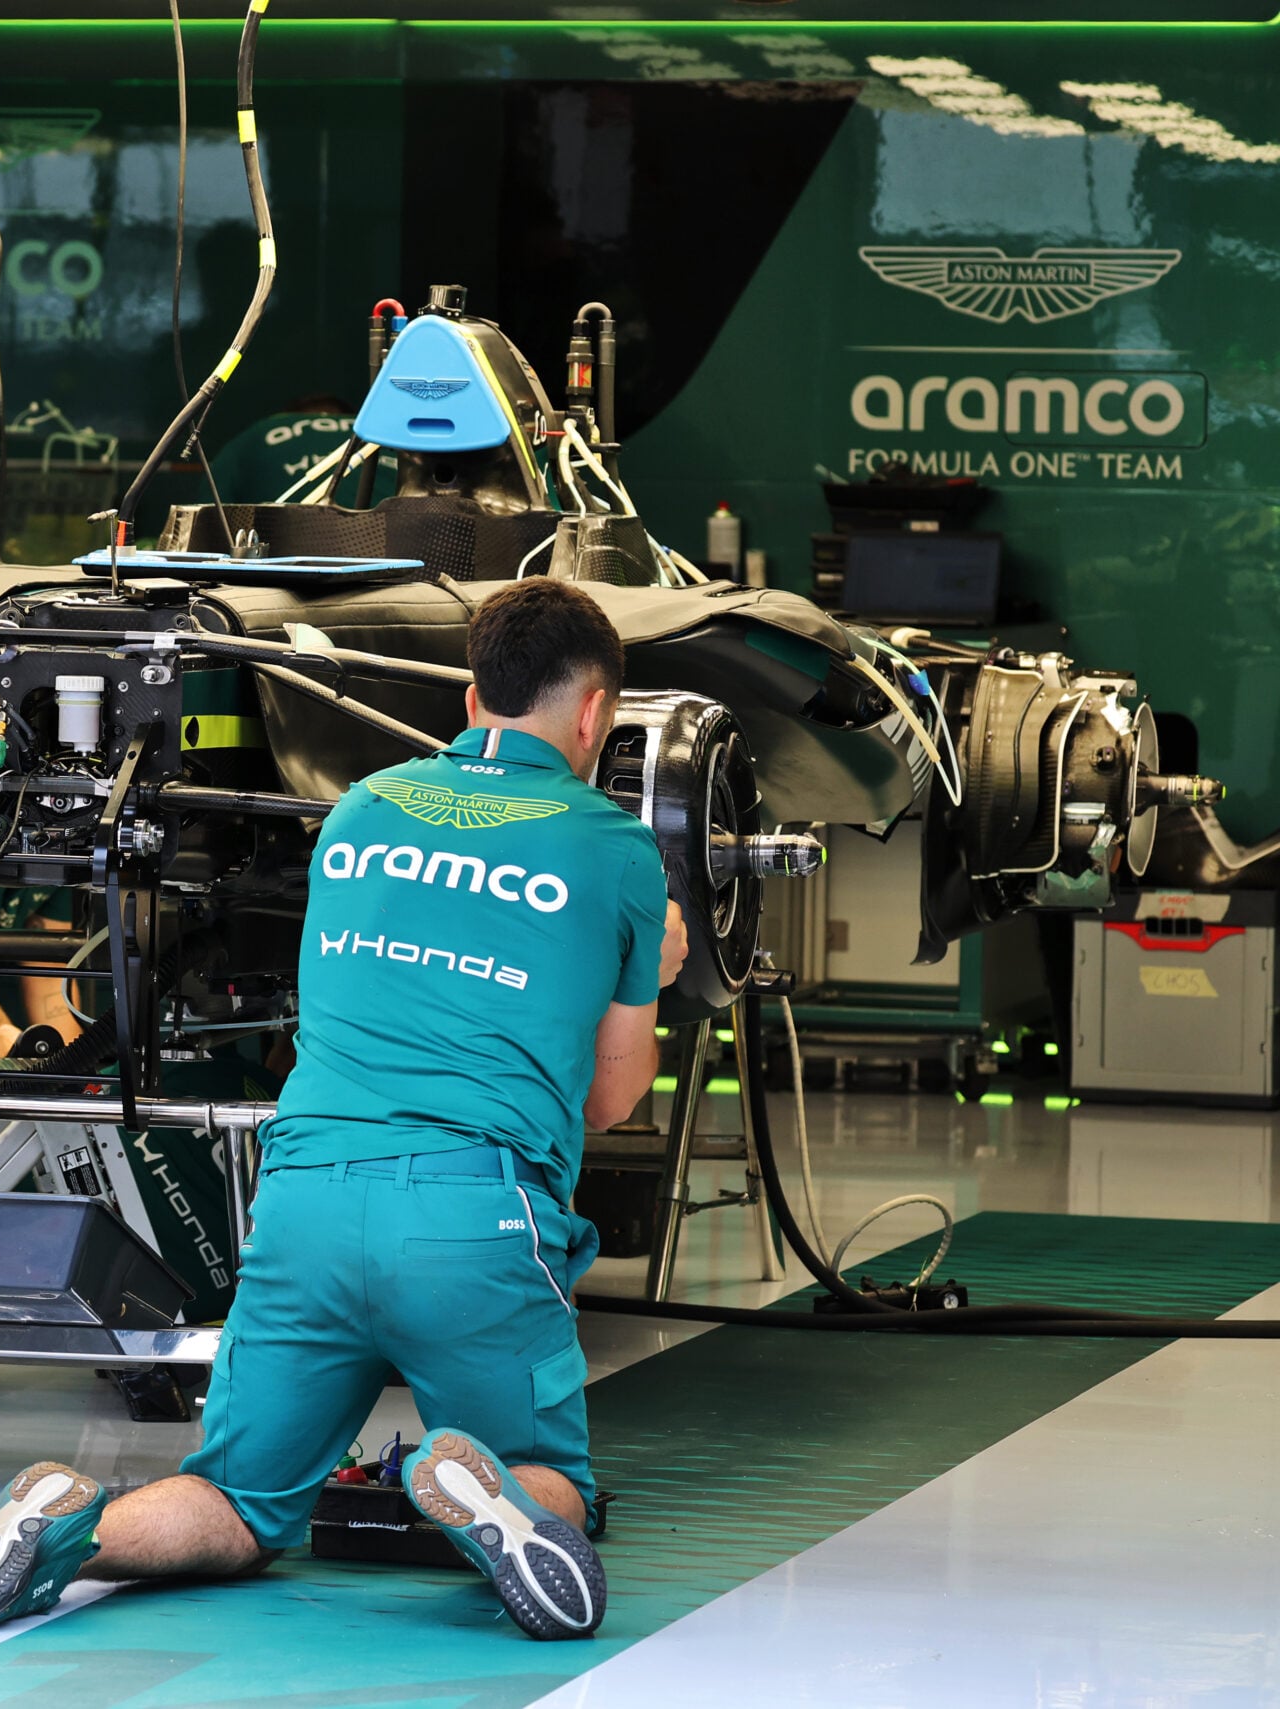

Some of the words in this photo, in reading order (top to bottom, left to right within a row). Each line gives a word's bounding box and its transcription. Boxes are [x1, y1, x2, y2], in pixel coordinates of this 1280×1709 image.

[951, 265, 1012, 281] ASTON
[1016, 266, 1088, 282] MARTIN
[22, 315, 103, 341] TEAM
[851, 375, 1185, 436] aramco
[265, 418, 356, 445] ara
[1097, 453, 1183, 480] TEAM
[460, 764, 506, 776] BOSS
[412, 790, 454, 806] ASTON
[455, 797, 505, 813] MARTIN
[322, 842, 569, 913] aramco
[351, 932, 529, 991] Honda
[152, 1164, 230, 1289] Honda
[499, 1219, 526, 1230] BOSS
